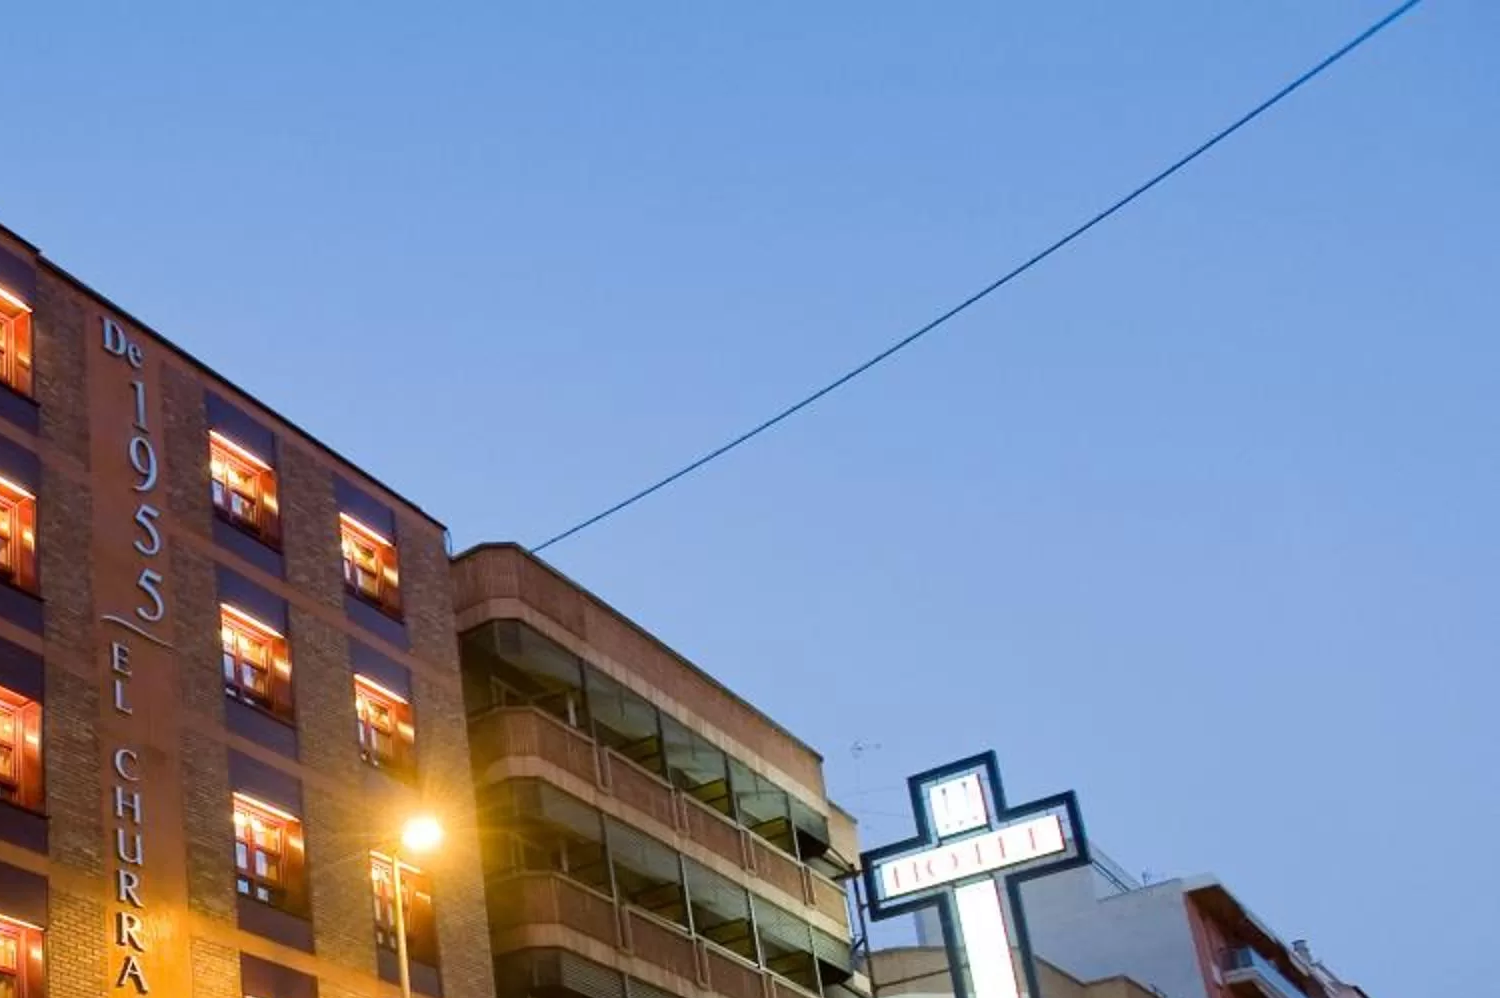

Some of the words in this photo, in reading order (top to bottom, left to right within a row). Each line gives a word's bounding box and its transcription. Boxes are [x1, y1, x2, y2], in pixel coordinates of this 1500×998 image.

[102, 316, 143, 369] De
[129, 380, 165, 622] 1955
[112, 640, 133, 716] EL
[114, 748, 148, 994] CHURRA
